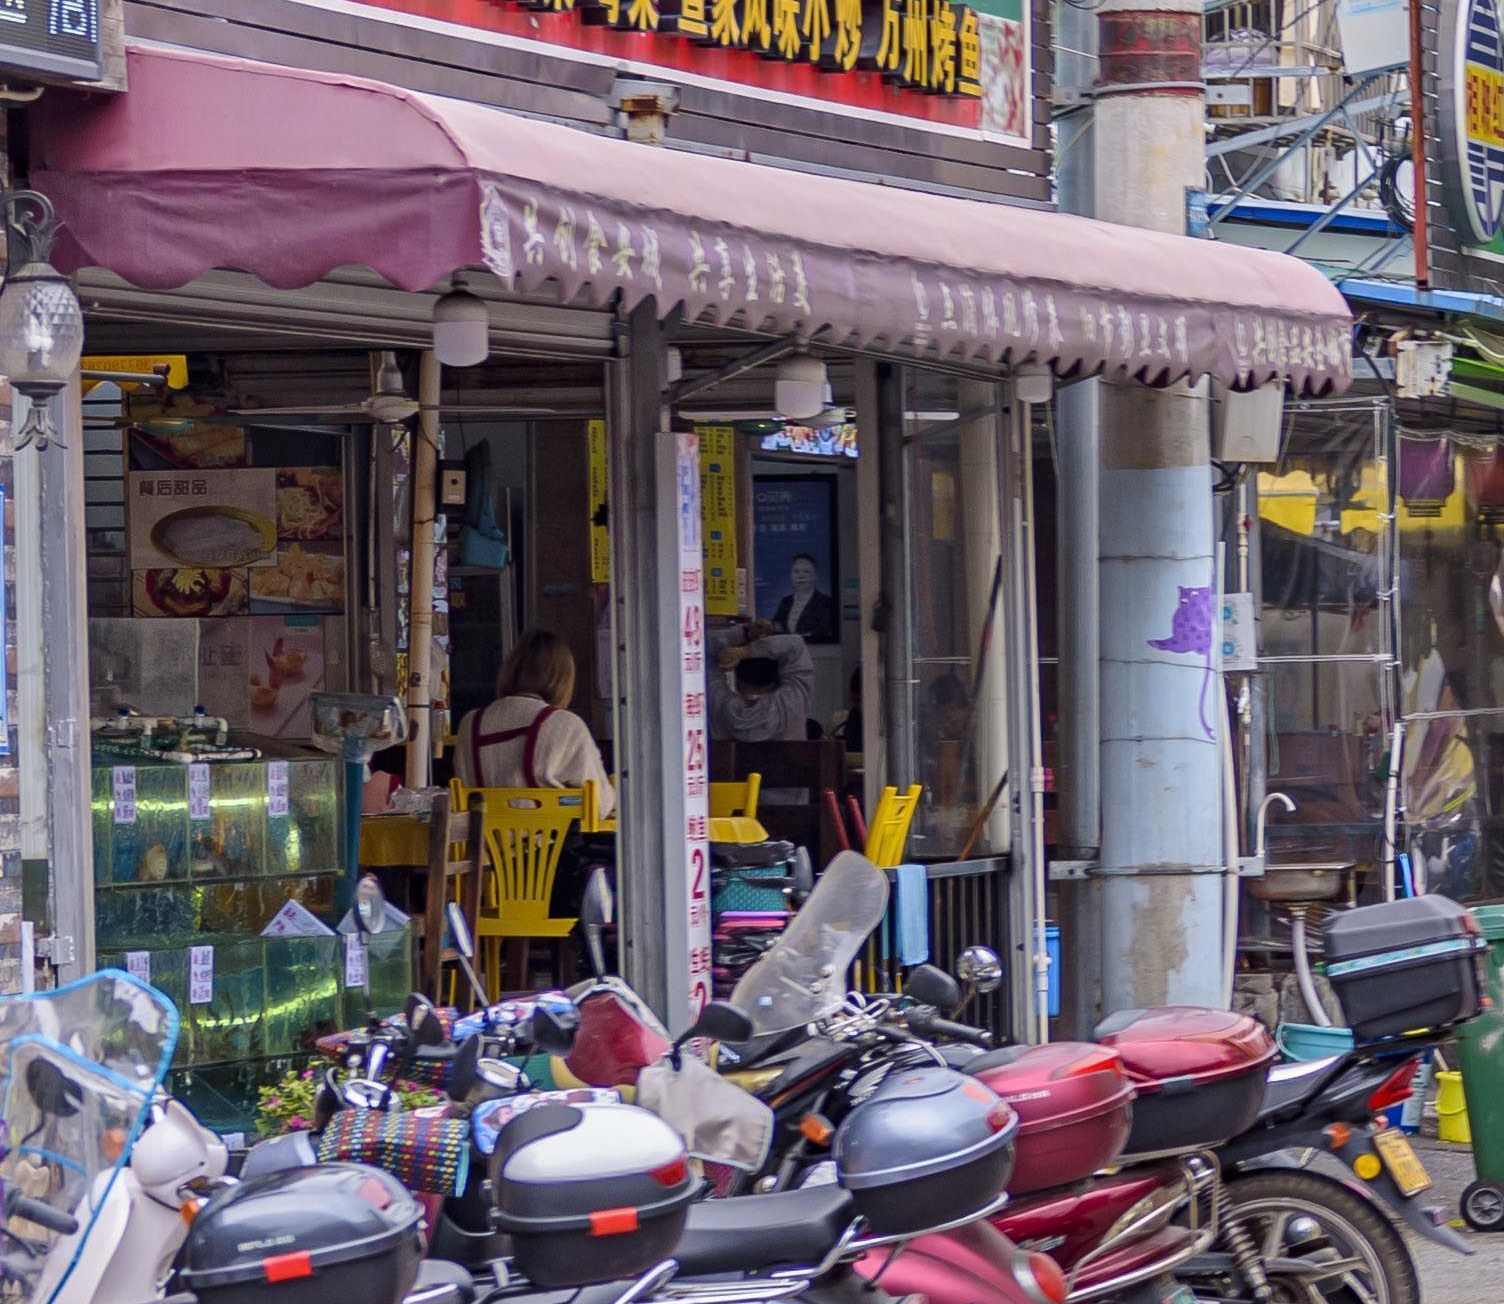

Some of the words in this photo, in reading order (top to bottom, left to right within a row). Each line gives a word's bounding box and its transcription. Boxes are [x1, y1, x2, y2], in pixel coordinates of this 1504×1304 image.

[139, 479, 208, 496] 餐后甜品
[686, 731, 704, 771] 25
[691, 849, 704, 900] 2
